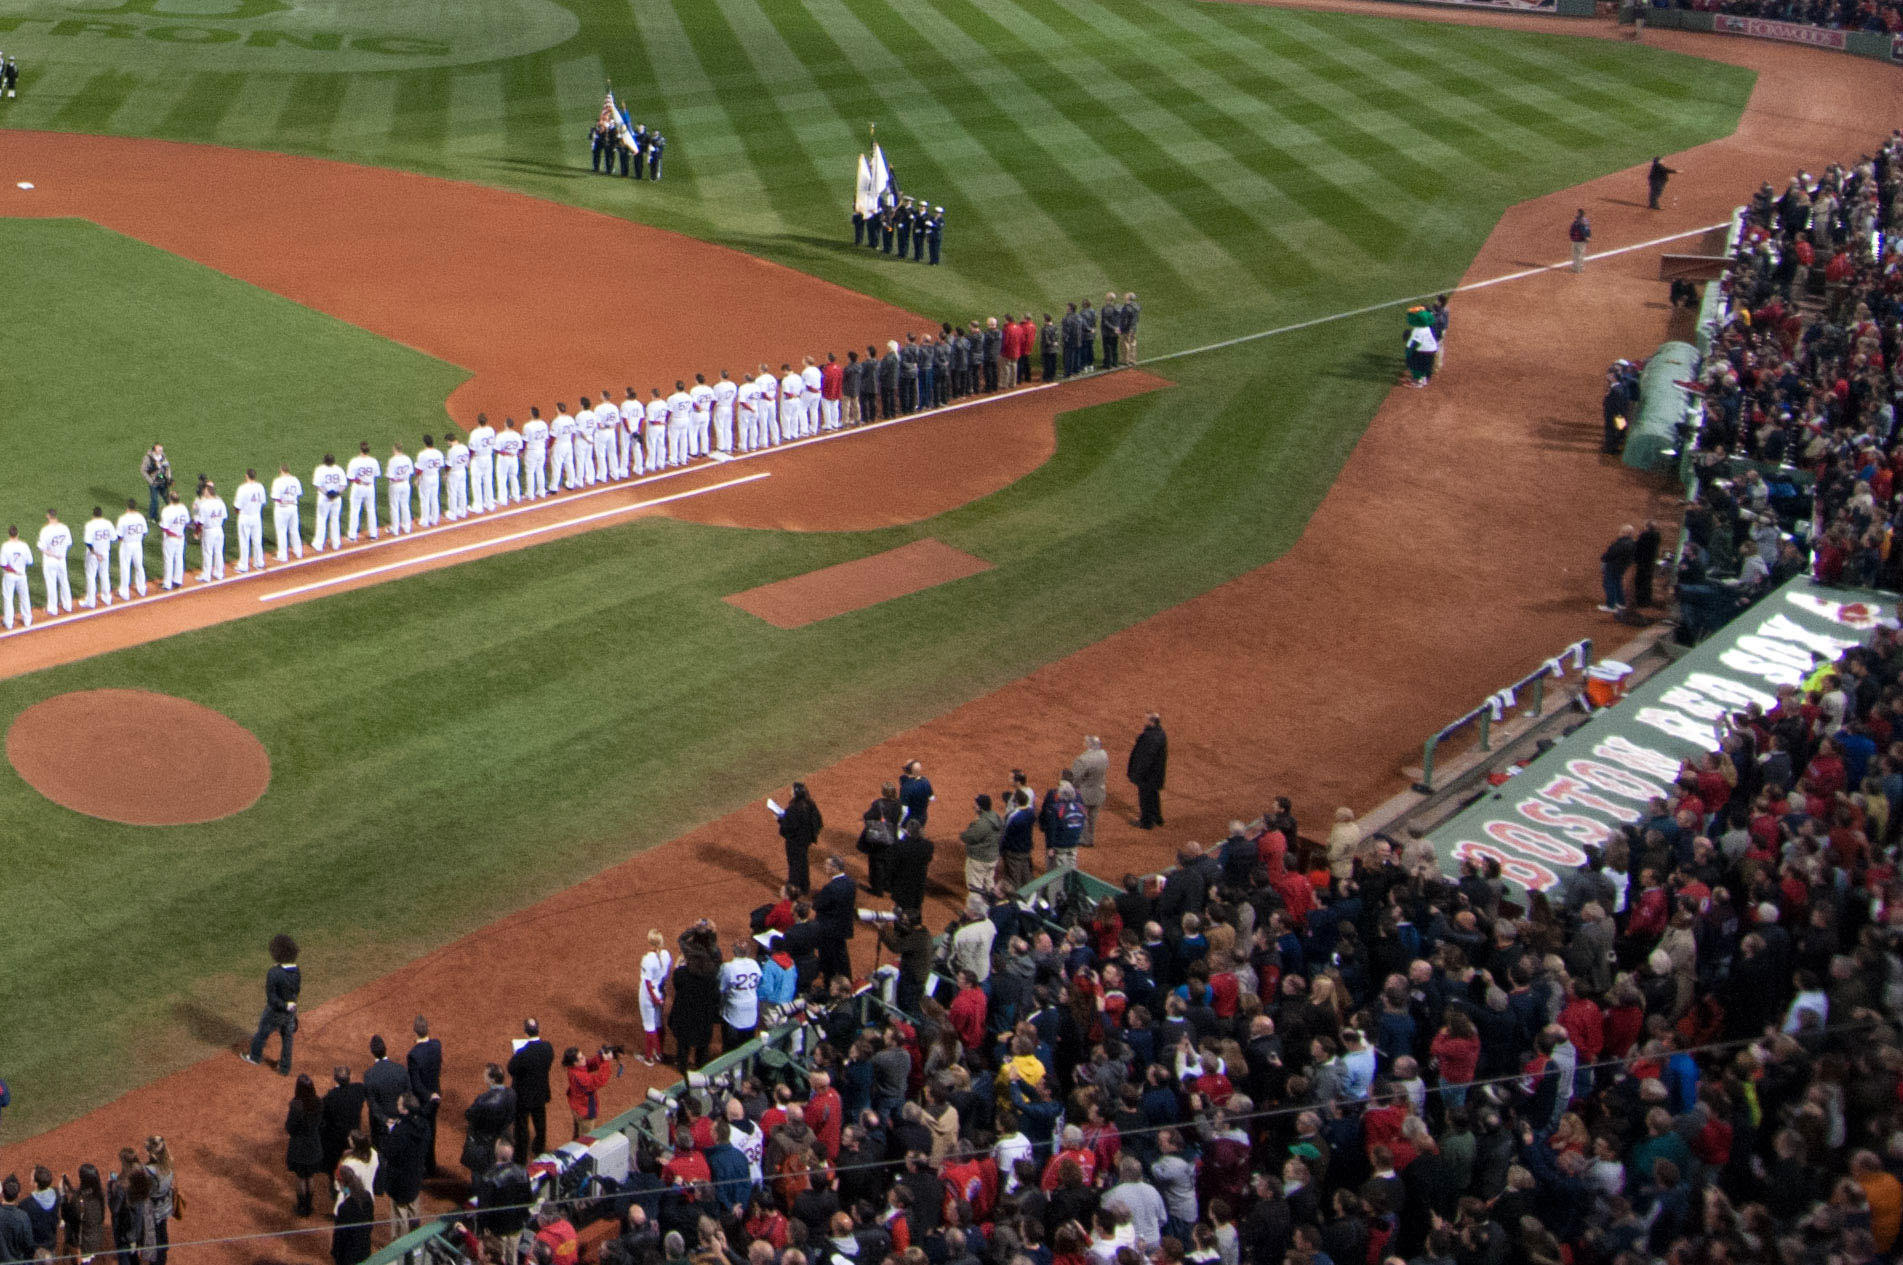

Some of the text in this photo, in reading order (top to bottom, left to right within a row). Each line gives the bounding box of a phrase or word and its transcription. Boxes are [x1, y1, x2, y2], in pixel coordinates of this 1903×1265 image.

[1751, 23, 1832, 42] FOXWOODS
[210, 507, 222, 519] 44
[13, 551, 22, 563] 7
[1451, 613, 1860, 892] BOSTON RED SOX
[736, 972, 758, 991] 23
[745, 1143, 762, 1165] 38
